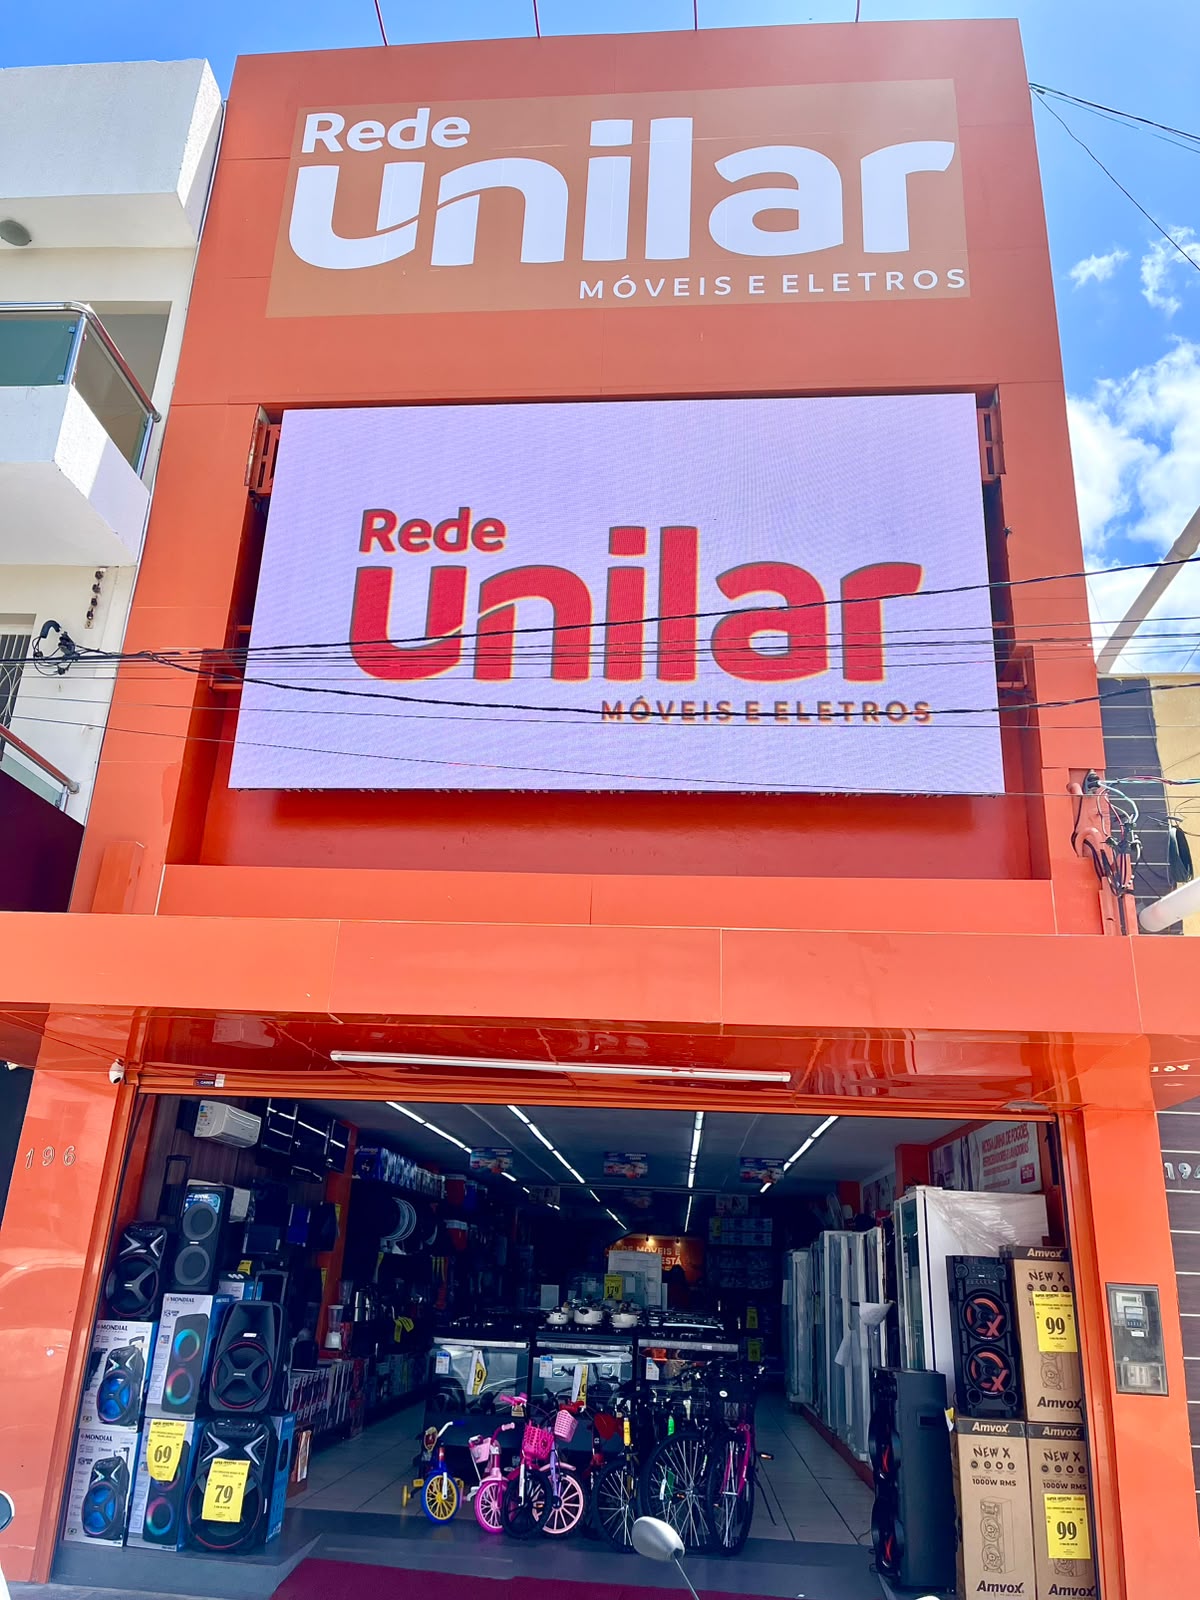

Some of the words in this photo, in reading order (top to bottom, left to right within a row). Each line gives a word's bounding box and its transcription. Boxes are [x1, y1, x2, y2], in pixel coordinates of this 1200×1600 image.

[301, 107, 471, 154] Rede
[288, 117, 956, 270] unilar
[579, 274, 732, 300] MÓVEIS
[749, 274, 766, 294] E
[782, 267, 967, 293] ELETROS
[358, 507, 507, 553] Rede
[349, 525, 923, 682] unilar
[601, 696, 732, 722] MÓVEIS
[745, 700, 760, 722] E
[774, 700, 932, 722] ELETROS
[25, 1145, 76, 1169] 196
[1027, 1247, 1062, 1258] Amvox
[1028, 1271, 1054, 1281] NEW
[1057, 1272, 1065, 1282] X
[1045, 1316, 1066, 1335] 99
[1037, 1396, 1082, 1409] Amvox
[972, 1421, 1009, 1433] Amvox
[1042, 1426, 1080, 1437] Amvox
[154, 1444, 172, 1463] 69
[973, 1446, 999, 1458] NEW
[1002, 1447, 1011, 1459] X
[1043, 1451, 1070, 1462] NEW
[1073, 1451, 1081, 1462] X
[972, 1478, 998, 1486] 1000W
[1043, 1482, 1069, 1490] 1000W
[214, 1485, 233, 1504] 79
[1056, 1521, 1077, 1540] 99
[976, 1580, 1024, 1594] Amvox
[1048, 1583, 1096, 1597] Amvox
